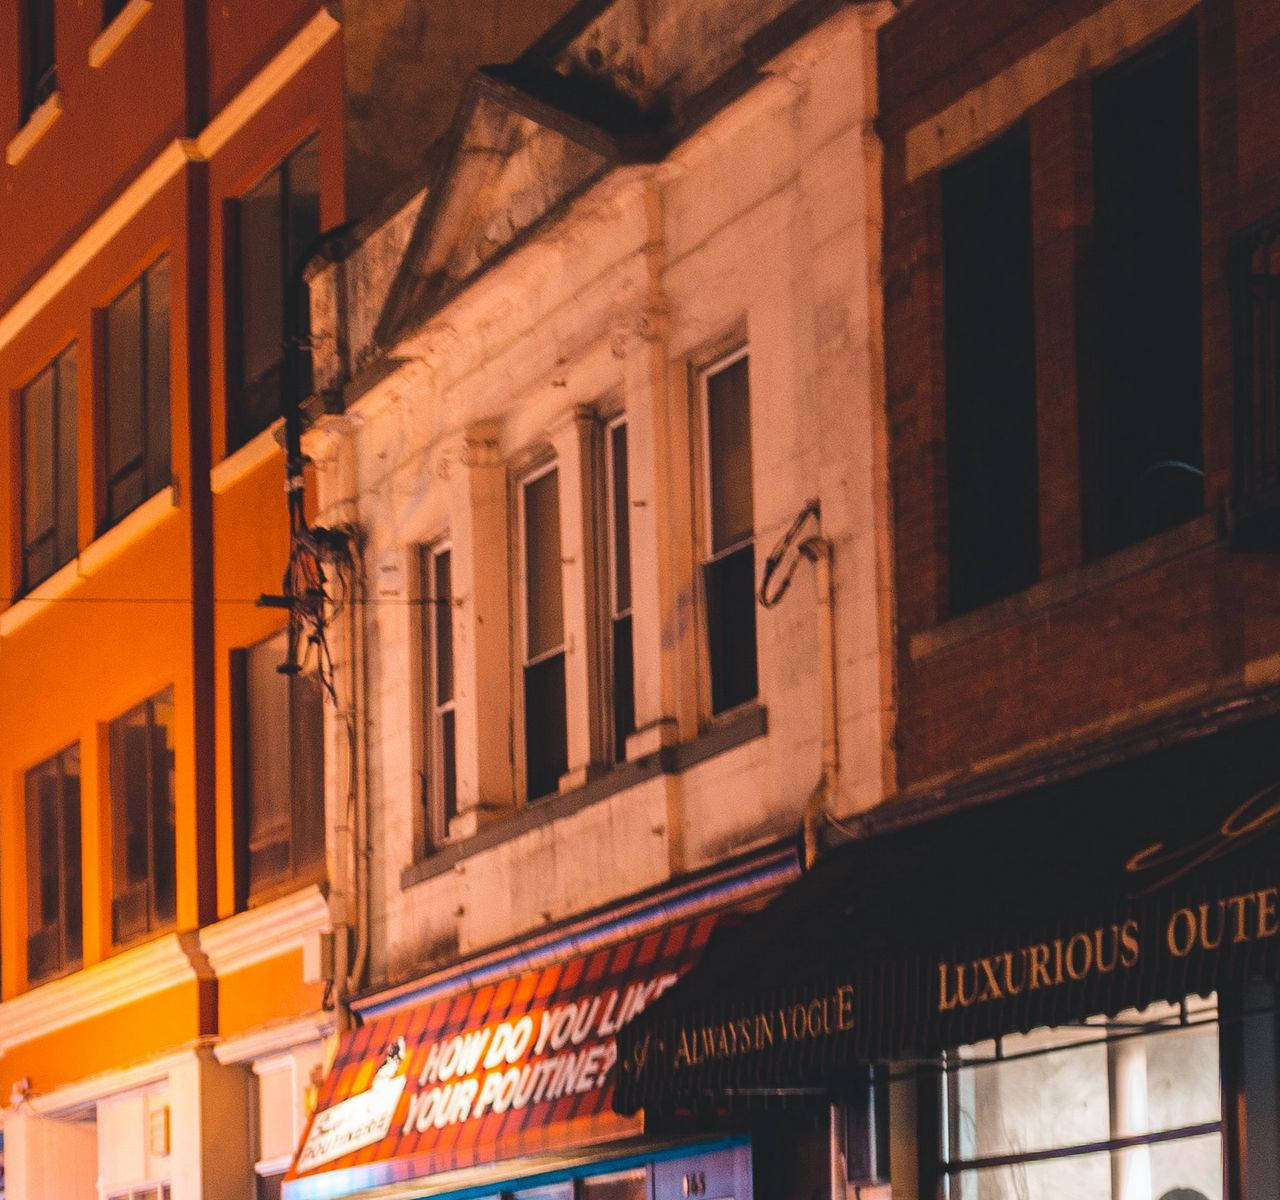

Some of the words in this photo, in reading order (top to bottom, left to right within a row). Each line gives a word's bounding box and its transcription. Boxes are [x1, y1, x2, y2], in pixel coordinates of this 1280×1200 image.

[938, 919, 1140, 1012] LUXURIOUS
[1167, 886, 1280, 957] OUTE
[418, 1027, 490, 1087] HOW
[483, 1015, 533, 1071] DO
[533, 995, 602, 1056] YOU
[673, 1015, 752, 1069] ALWAYS
[754, 1012, 774, 1050] IN
[778, 984, 855, 1041] VOGUE
[402, 1077, 479, 1136] YOUR
[472, 1041, 618, 1119] POUTINE?
